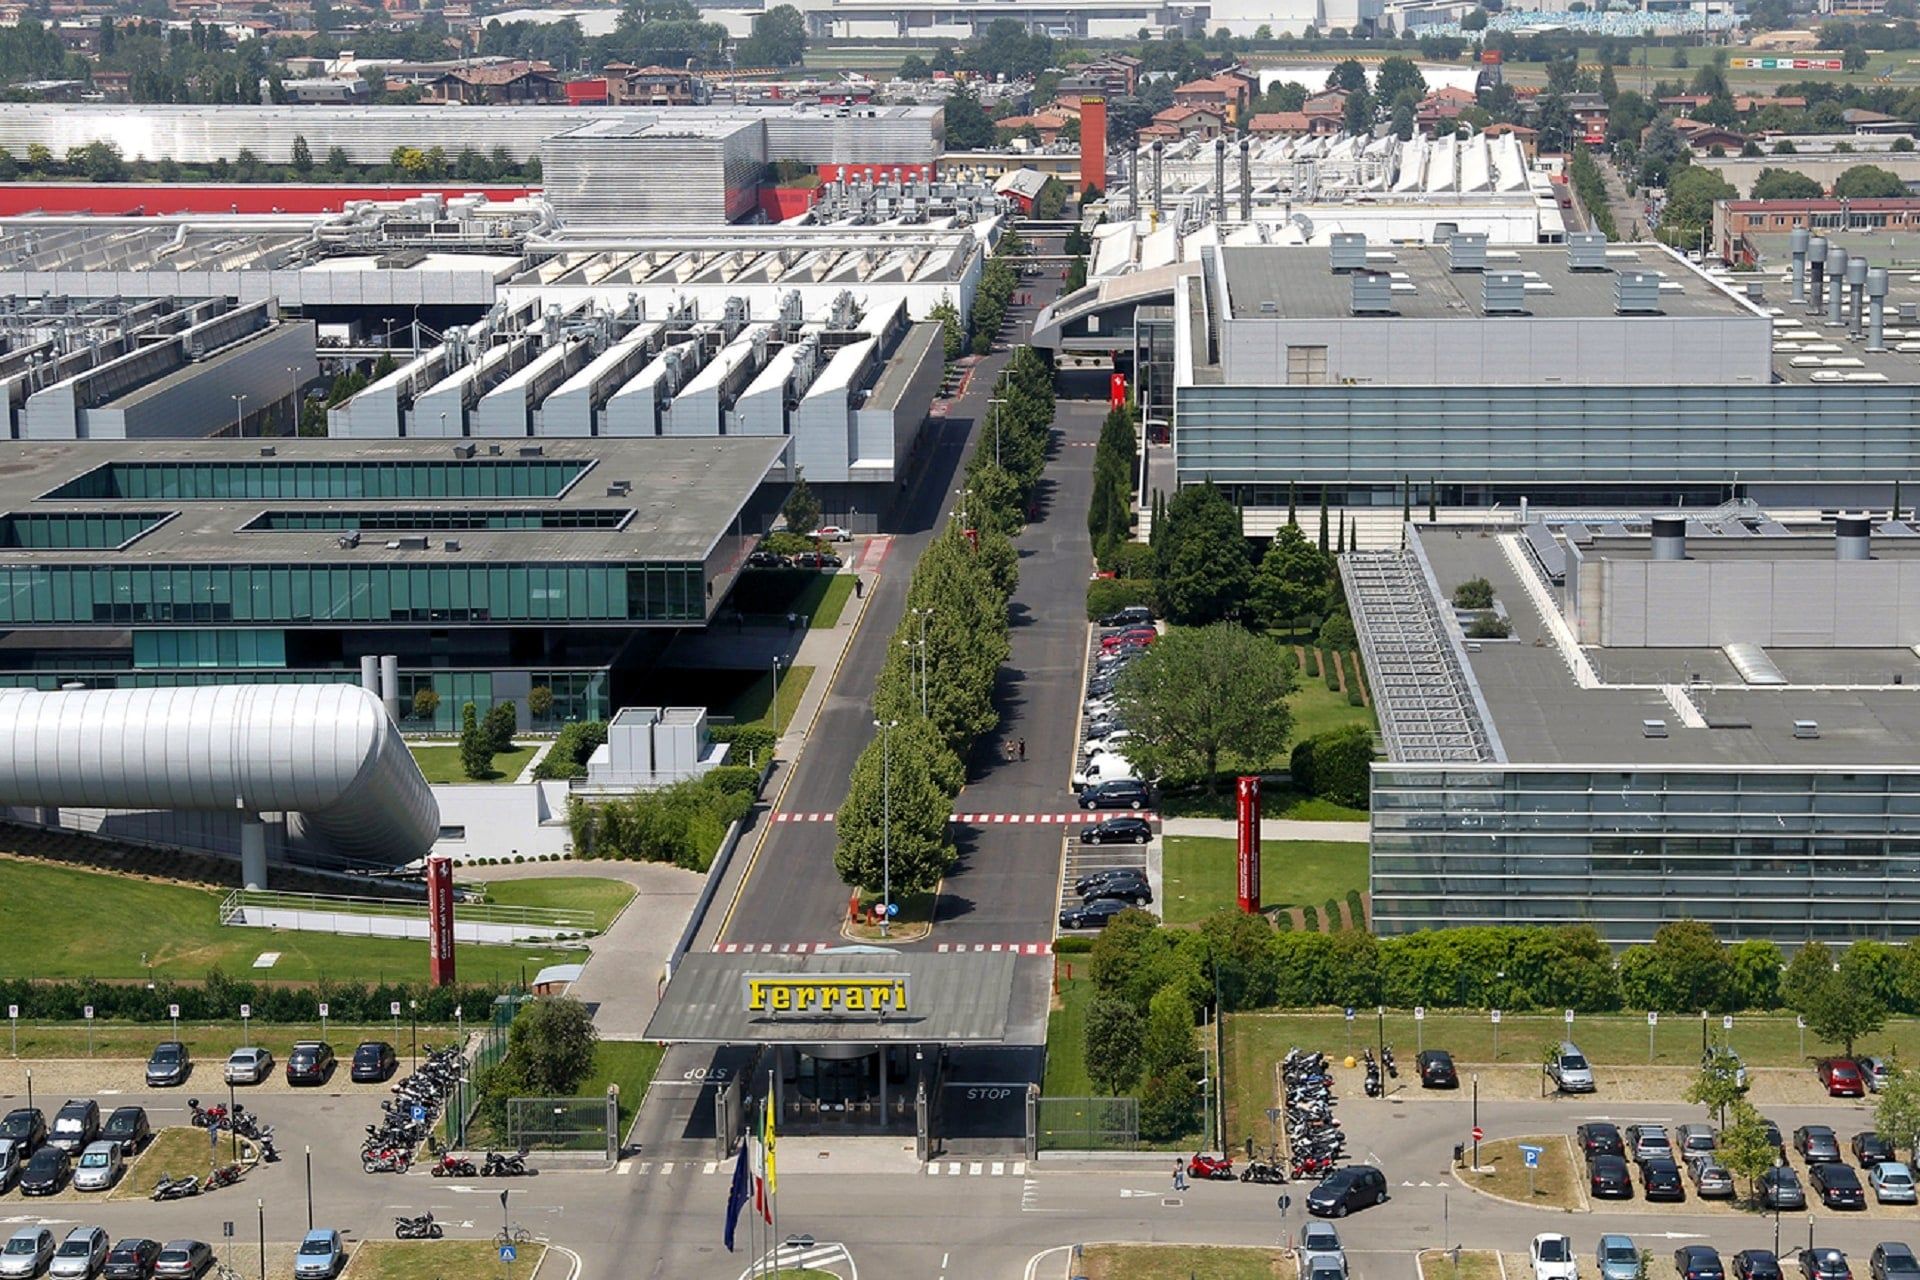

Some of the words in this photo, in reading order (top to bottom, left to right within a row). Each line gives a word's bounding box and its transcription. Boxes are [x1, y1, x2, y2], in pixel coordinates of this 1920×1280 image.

[749, 979, 906, 1009] Ferrari
[683, 1068, 728, 1079] STOP
[967, 1088, 1011, 1100] STOP
[1527, 1152, 1535, 1162] P
